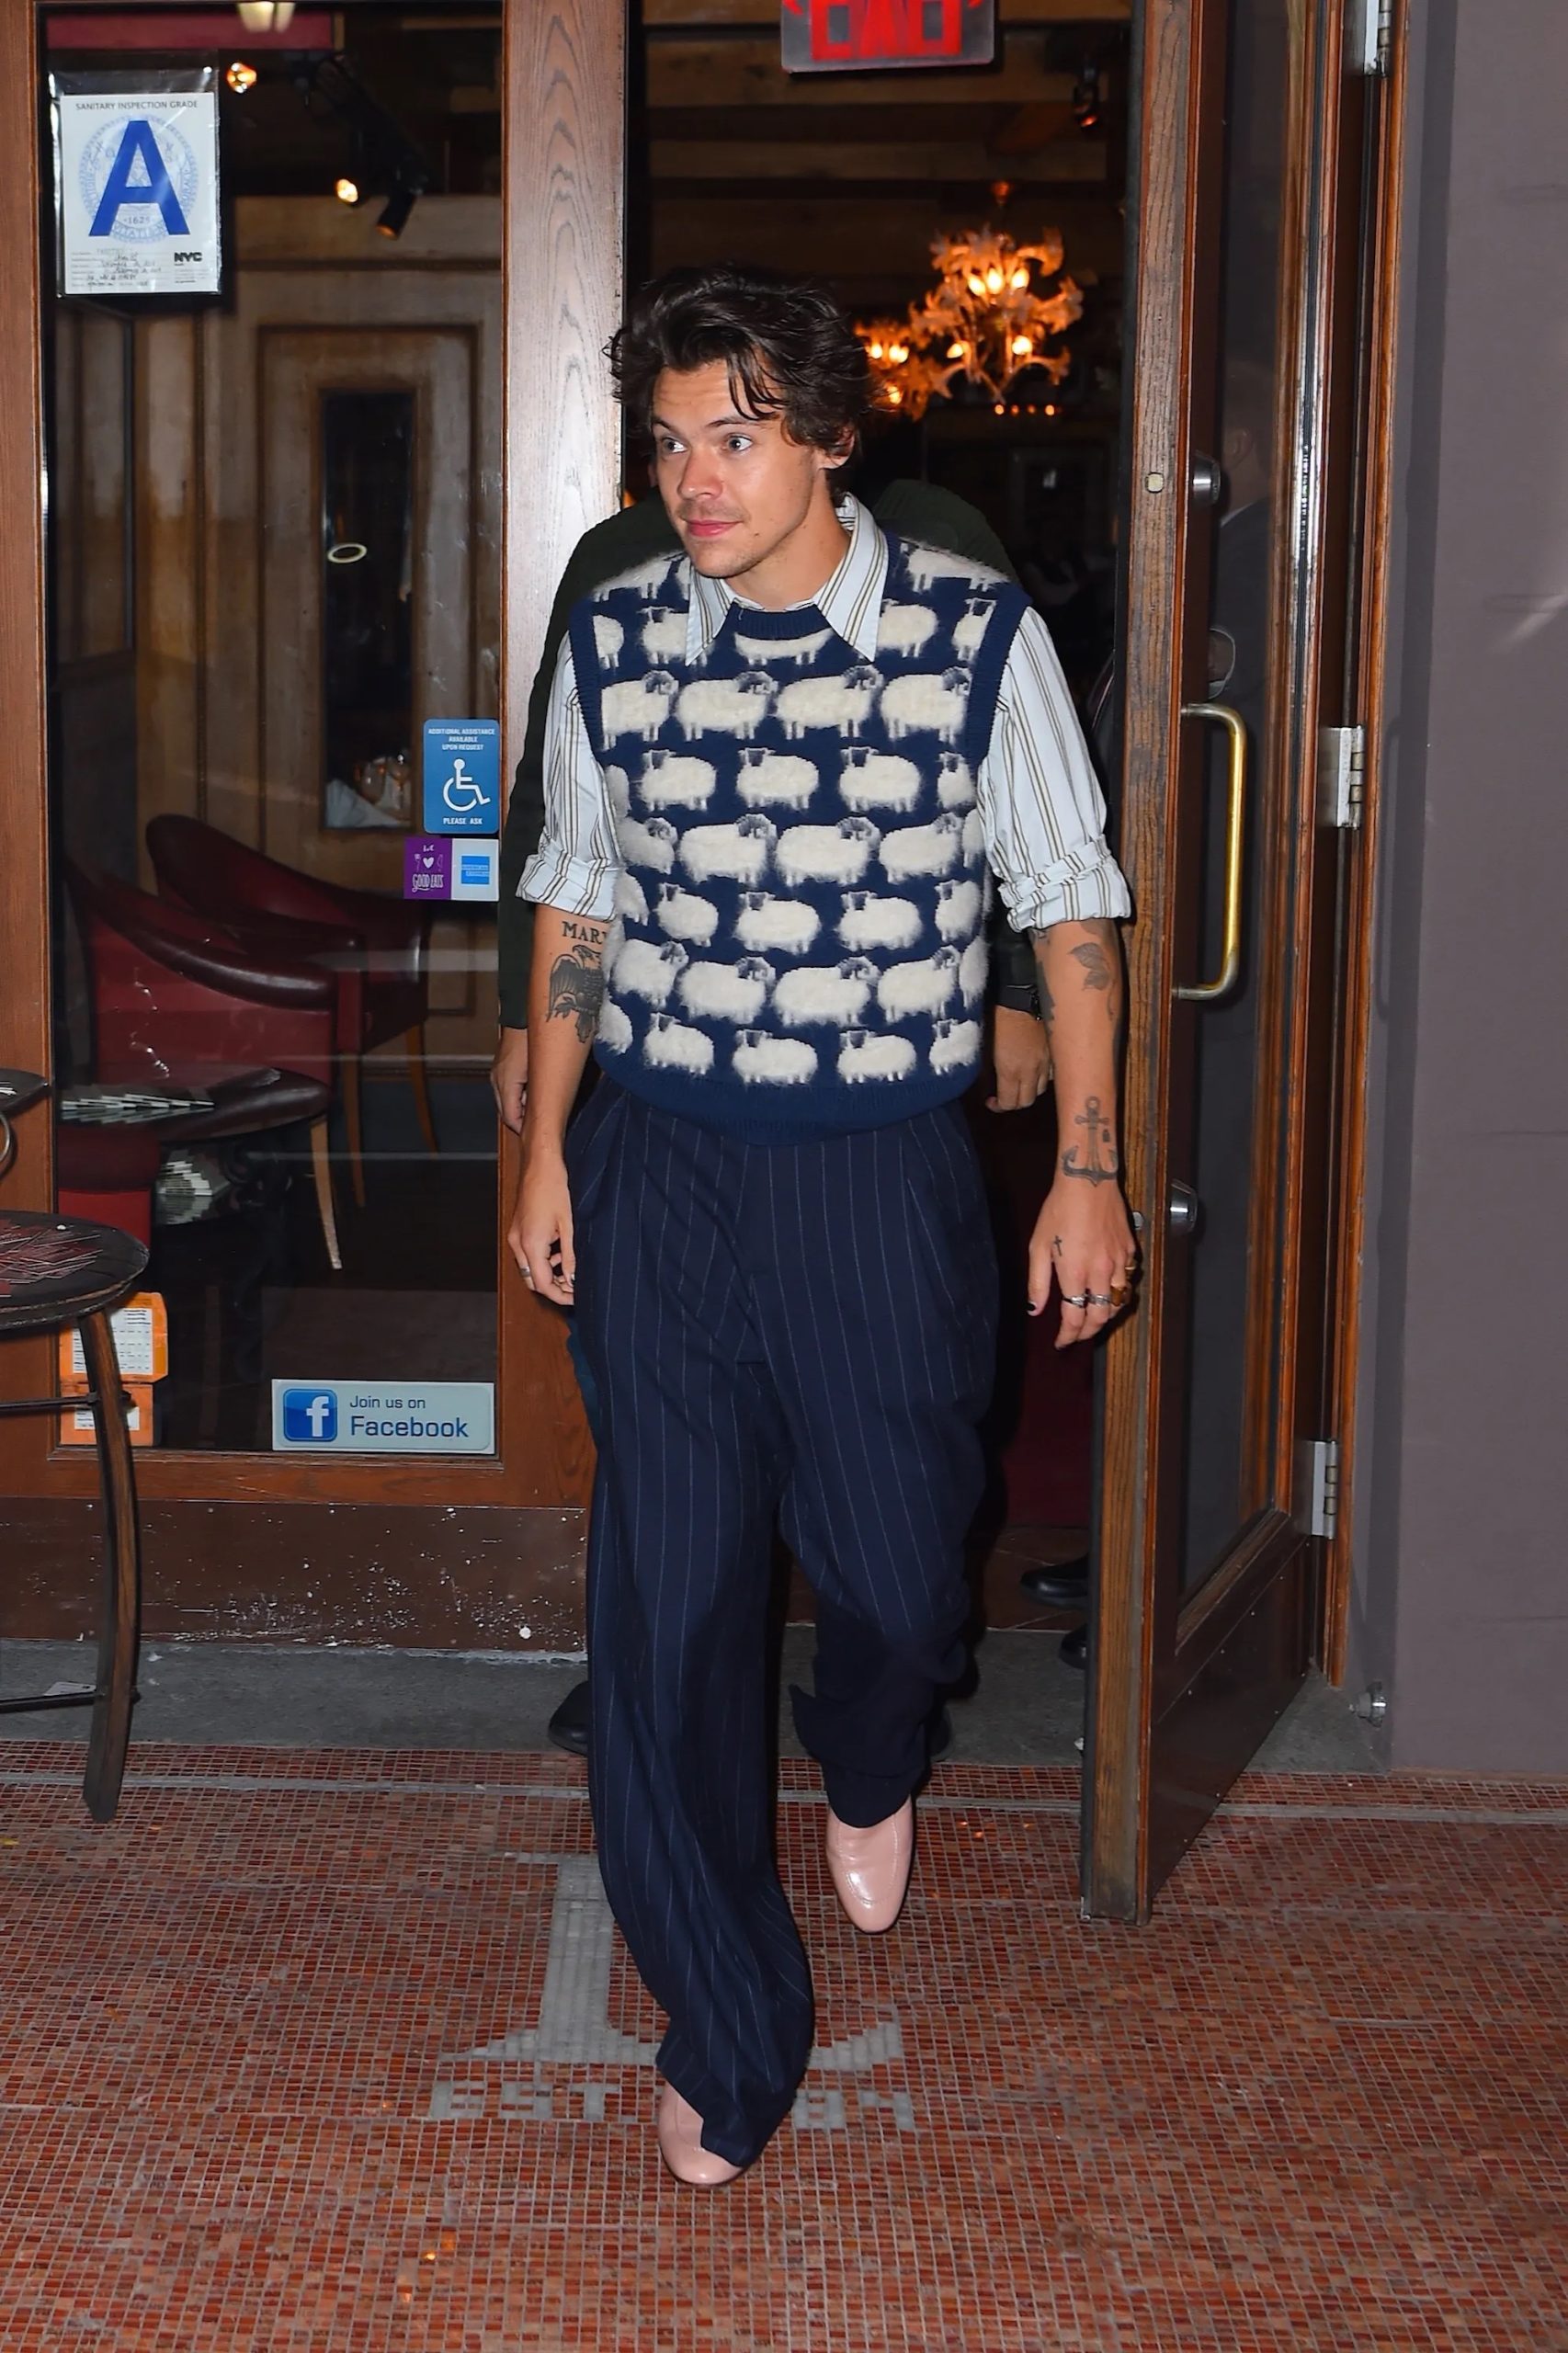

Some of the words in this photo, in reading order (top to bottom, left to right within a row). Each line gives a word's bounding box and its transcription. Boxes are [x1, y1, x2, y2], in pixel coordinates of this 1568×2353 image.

[169, 100, 198, 108] GRADE
[88, 120, 191, 236] A
[174, 252, 202, 263] NYC
[412, 873, 430, 892] GOOD
[349, 1395, 381, 1408] Join
[385, 1399, 403, 1409] us
[408, 1399, 426, 1409] on
[351, 1416, 469, 1438] Facebook
